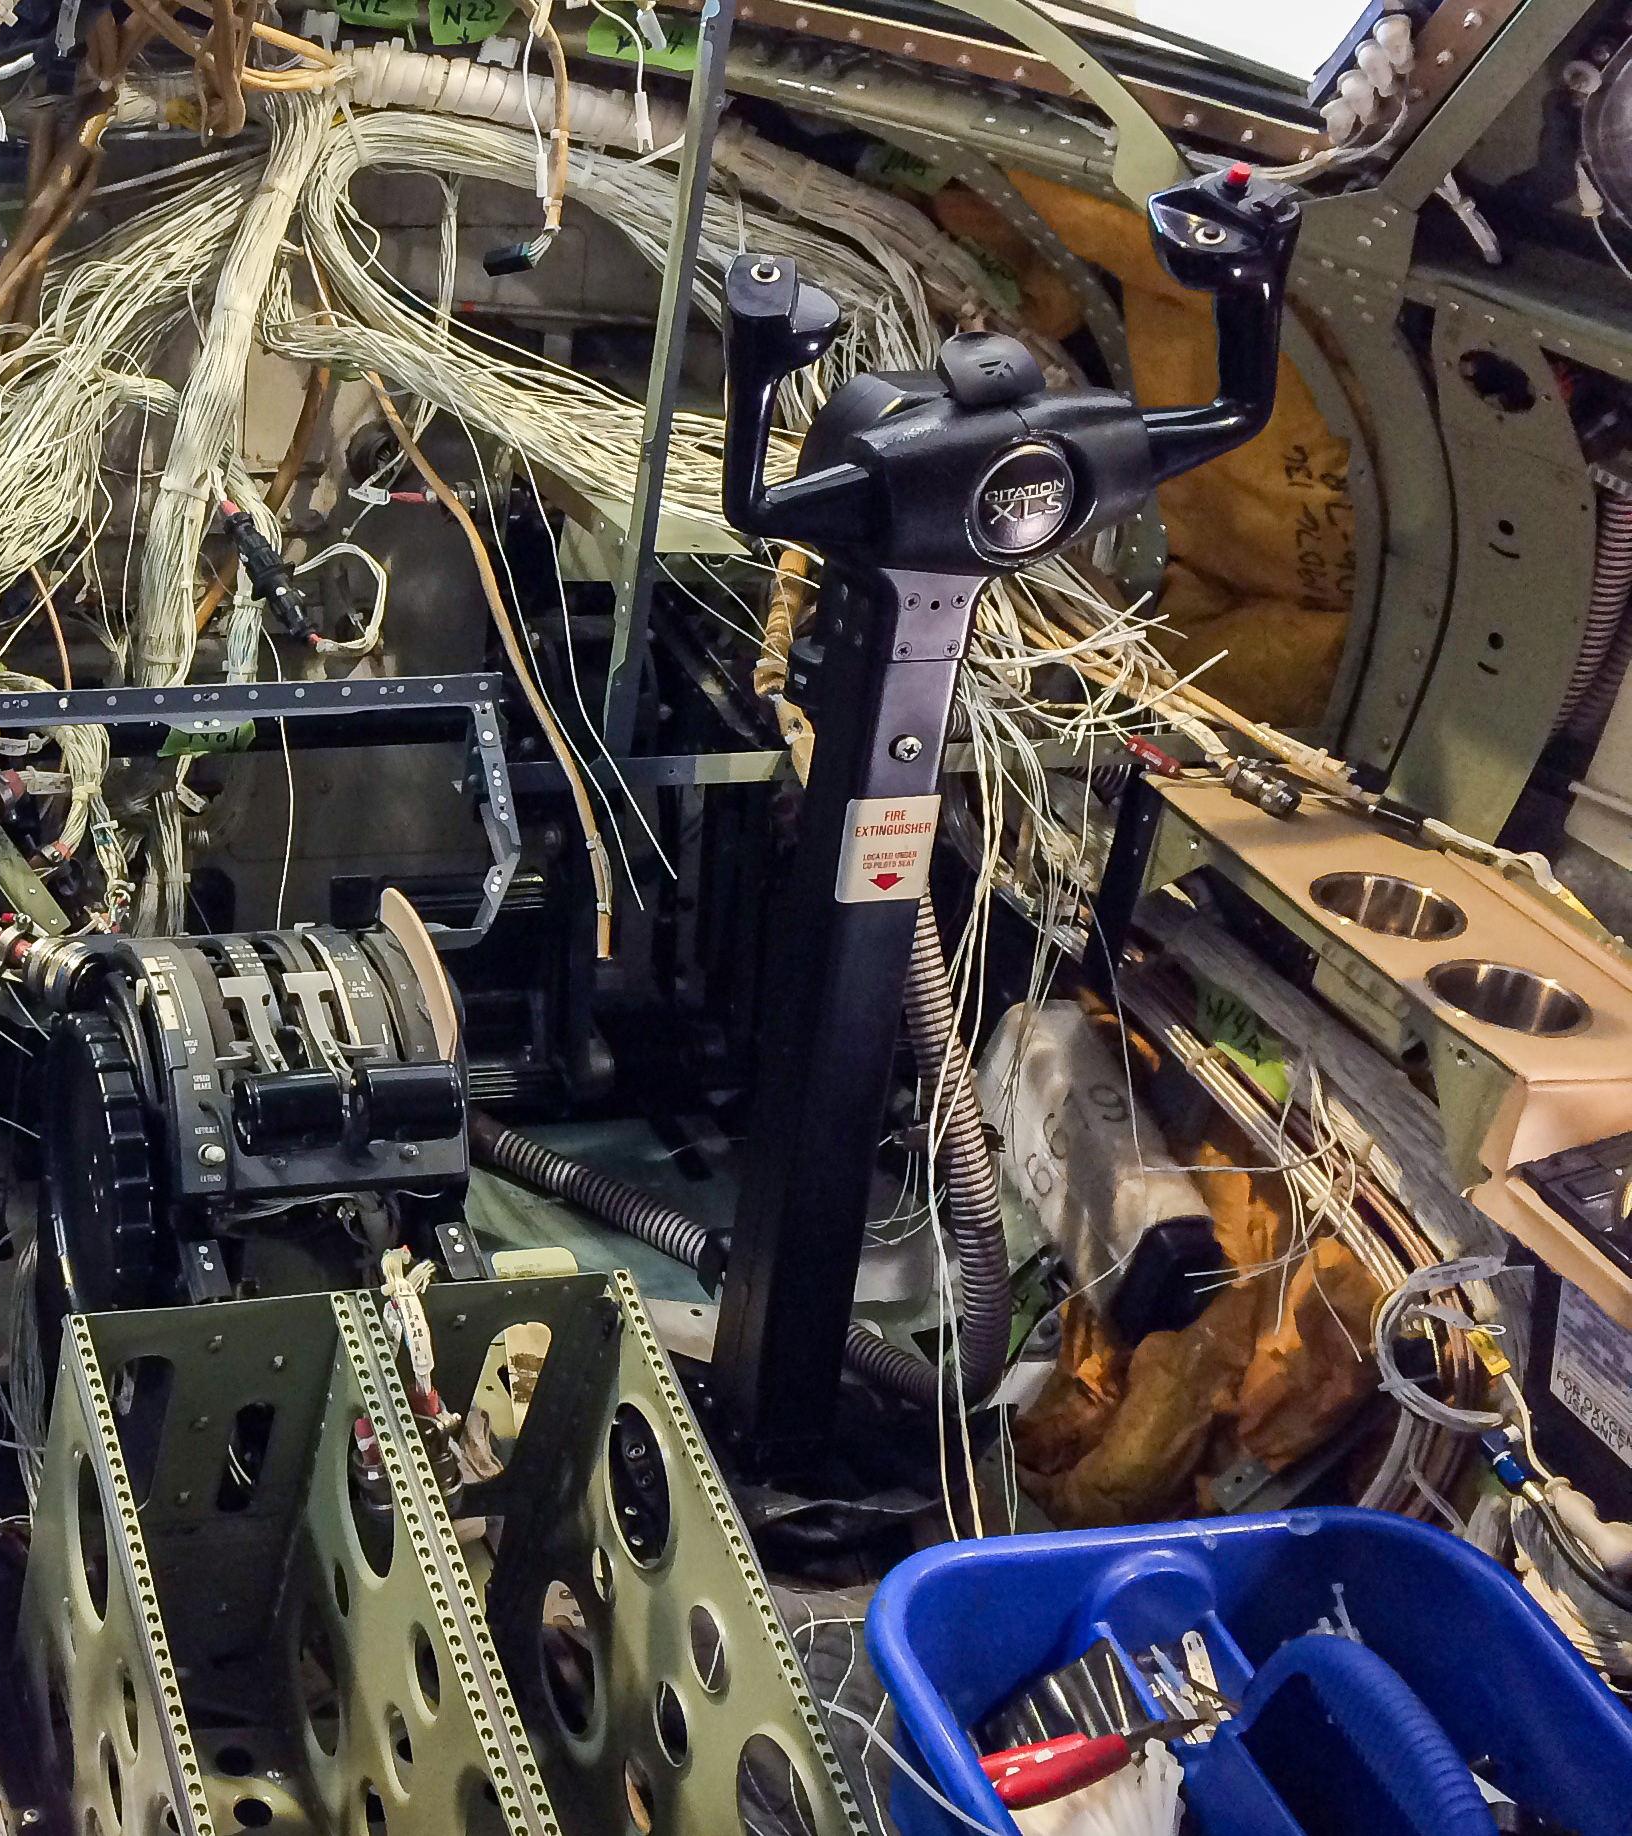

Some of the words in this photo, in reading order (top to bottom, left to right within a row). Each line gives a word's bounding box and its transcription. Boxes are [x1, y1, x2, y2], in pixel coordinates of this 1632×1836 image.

[985, 477, 1065, 502] CITATION
[990, 493, 1063, 525] XLS
[884, 809, 907, 821] FIRE
[854, 822, 932, 838] EXTINGUISHER
[1556, 1370, 1581, 1402] FOR
[1564, 1390, 1587, 1421] USE
[1591, 1417, 1624, 1452] ONLY
